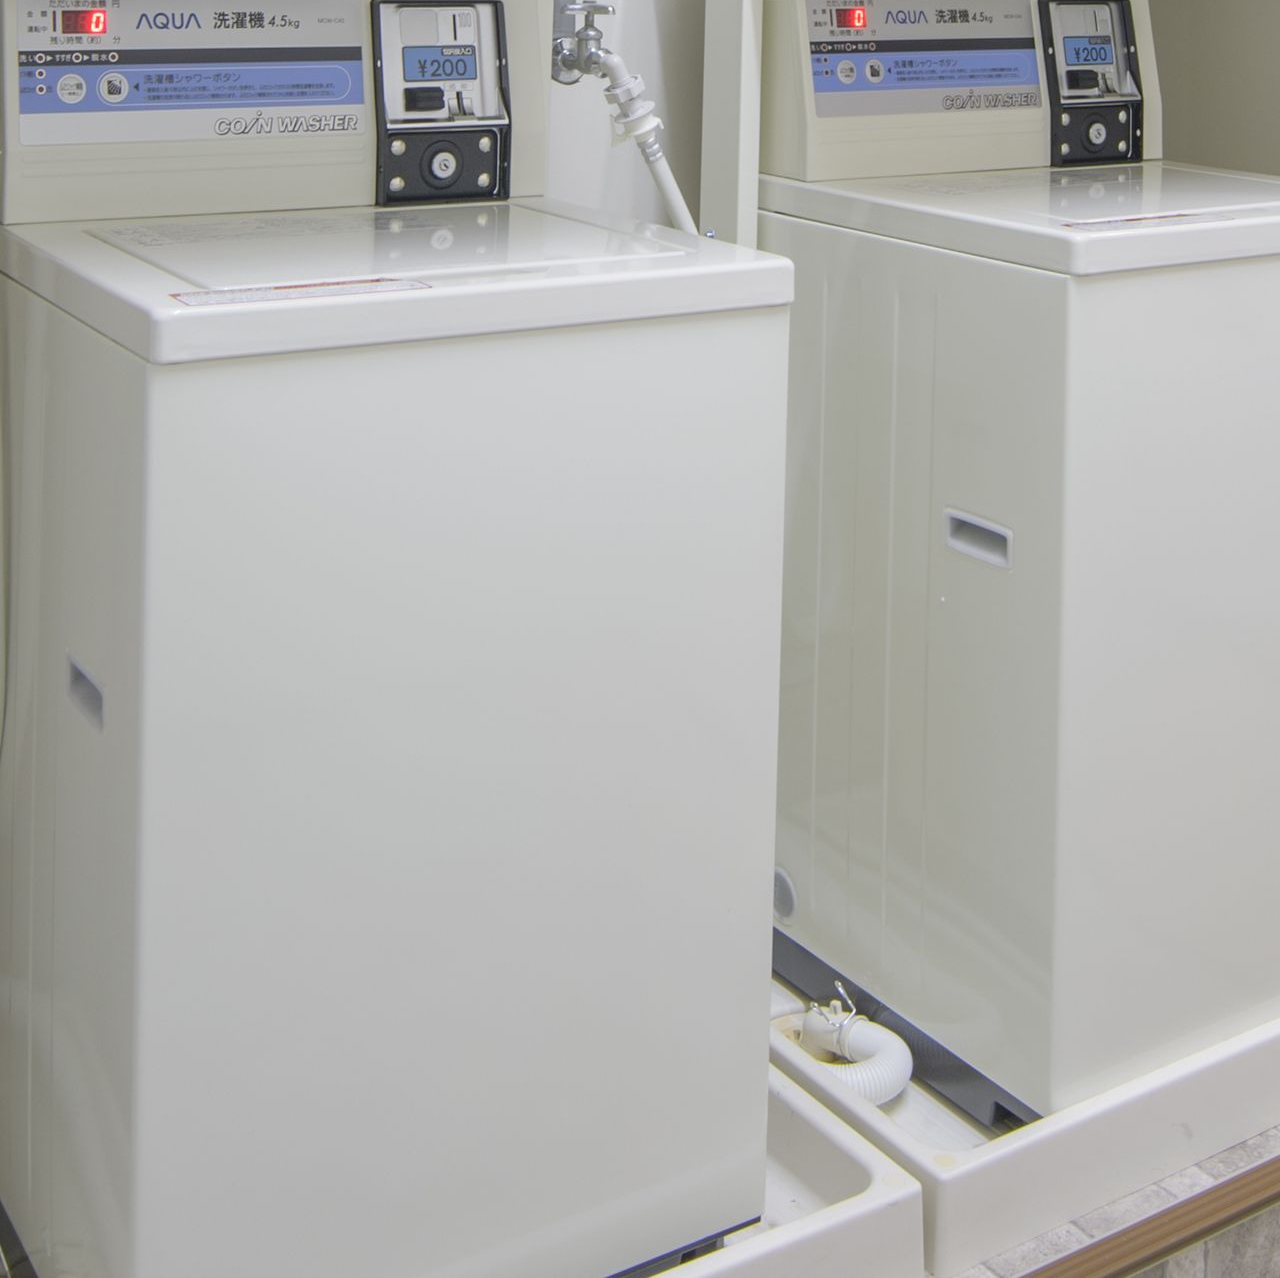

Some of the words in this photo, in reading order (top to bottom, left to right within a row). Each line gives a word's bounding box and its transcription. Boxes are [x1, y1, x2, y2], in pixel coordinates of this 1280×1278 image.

[49, 0, 107, 8] ただいまの金額
[111, 0, 120, 9] 円
[90, 12, 105, 33] 0
[135, 12, 202, 30] AQUA
[212, 11, 265, 29] 洗濯機
[267, 14, 300, 30] 4.5kg
[853, 9, 864, 27] 0
[885, 10, 929, 24] AQUA
[934, 9, 970, 24] 洗濯機
[971, 12, 994, 24] 4.5kg
[112, 36, 121, 44] 分
[1074, 46, 1108, 63] ¥200
[417, 59, 468, 78] ¥200
[144, 73, 241, 85] 洗濯槽シャワーボタン
[983, 92, 1038, 109] WASHER
[277, 114, 359, 133] WASHER
